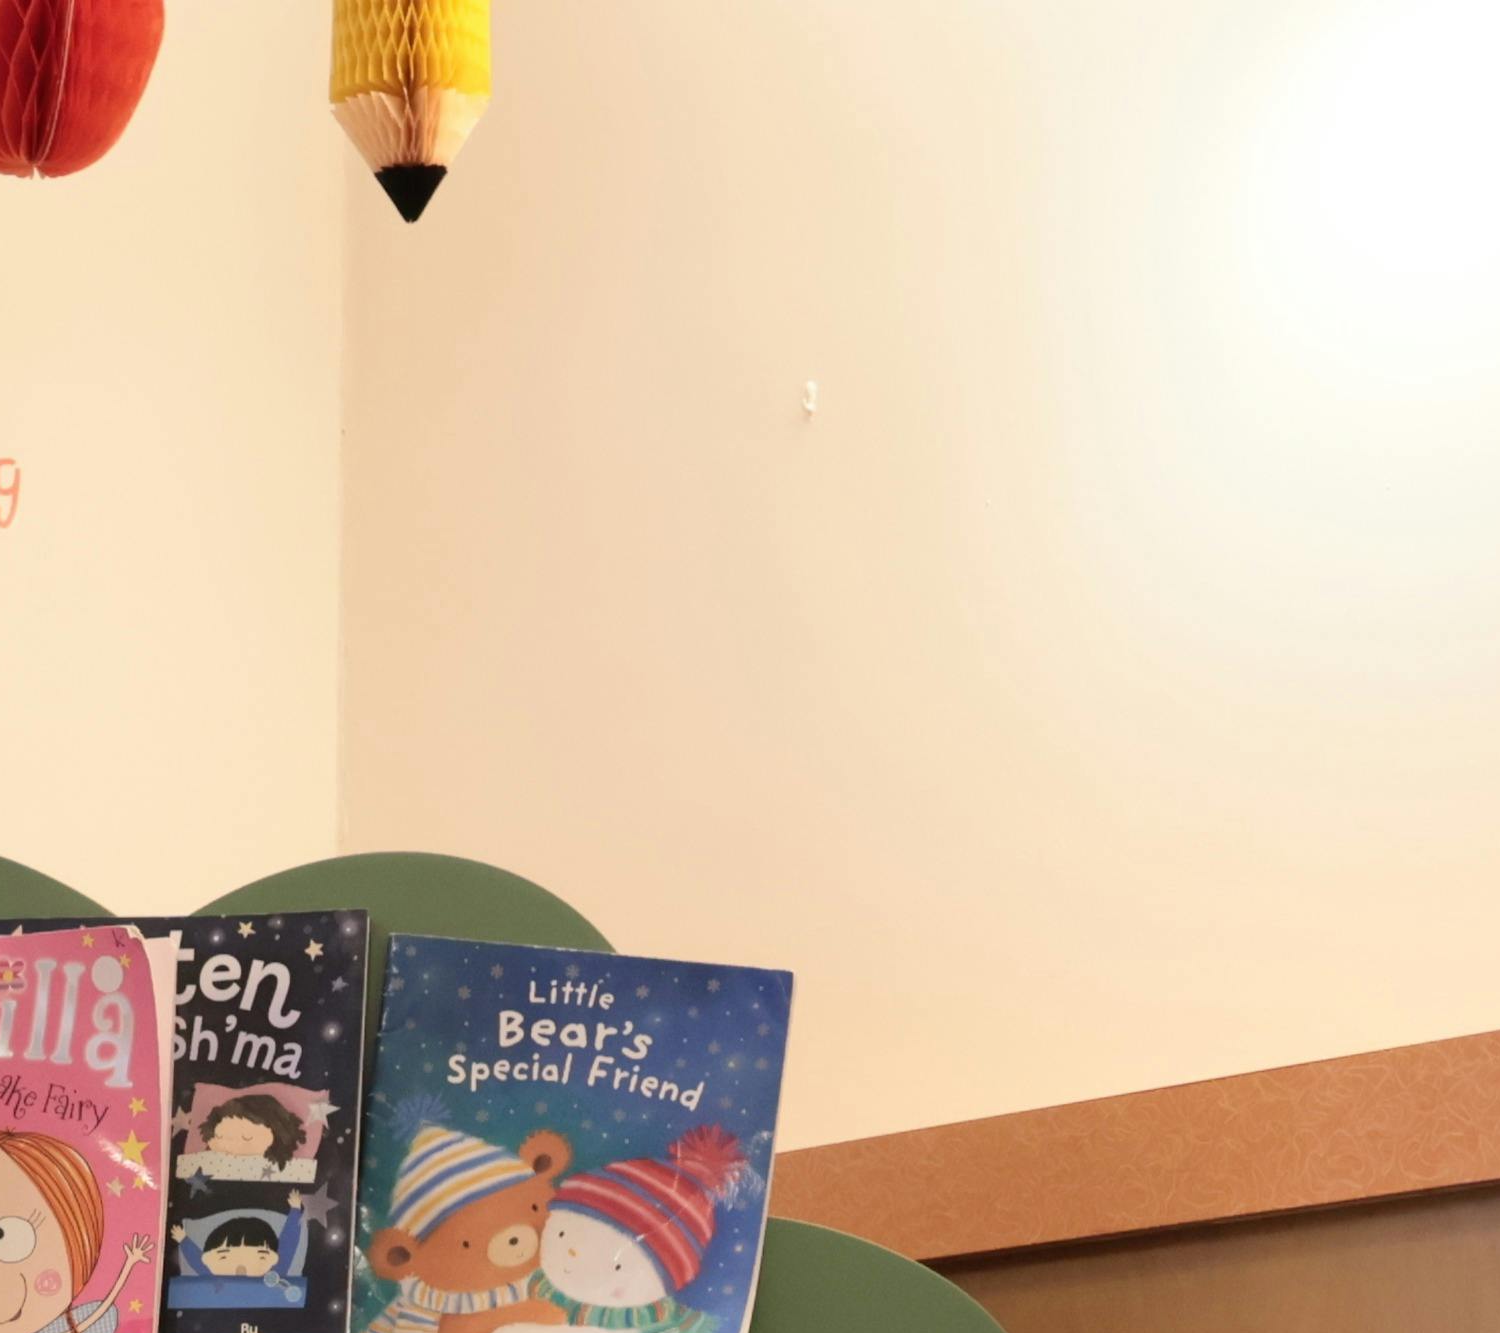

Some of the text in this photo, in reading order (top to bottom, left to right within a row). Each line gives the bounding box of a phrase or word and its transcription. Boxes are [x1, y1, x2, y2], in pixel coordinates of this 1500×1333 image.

[528, 979, 615, 1010] Little
[498, 1009, 653, 1060] Bear's
[447, 1052, 705, 1113] Special Friend
[42, 1083, 111, 1137] Fairy
